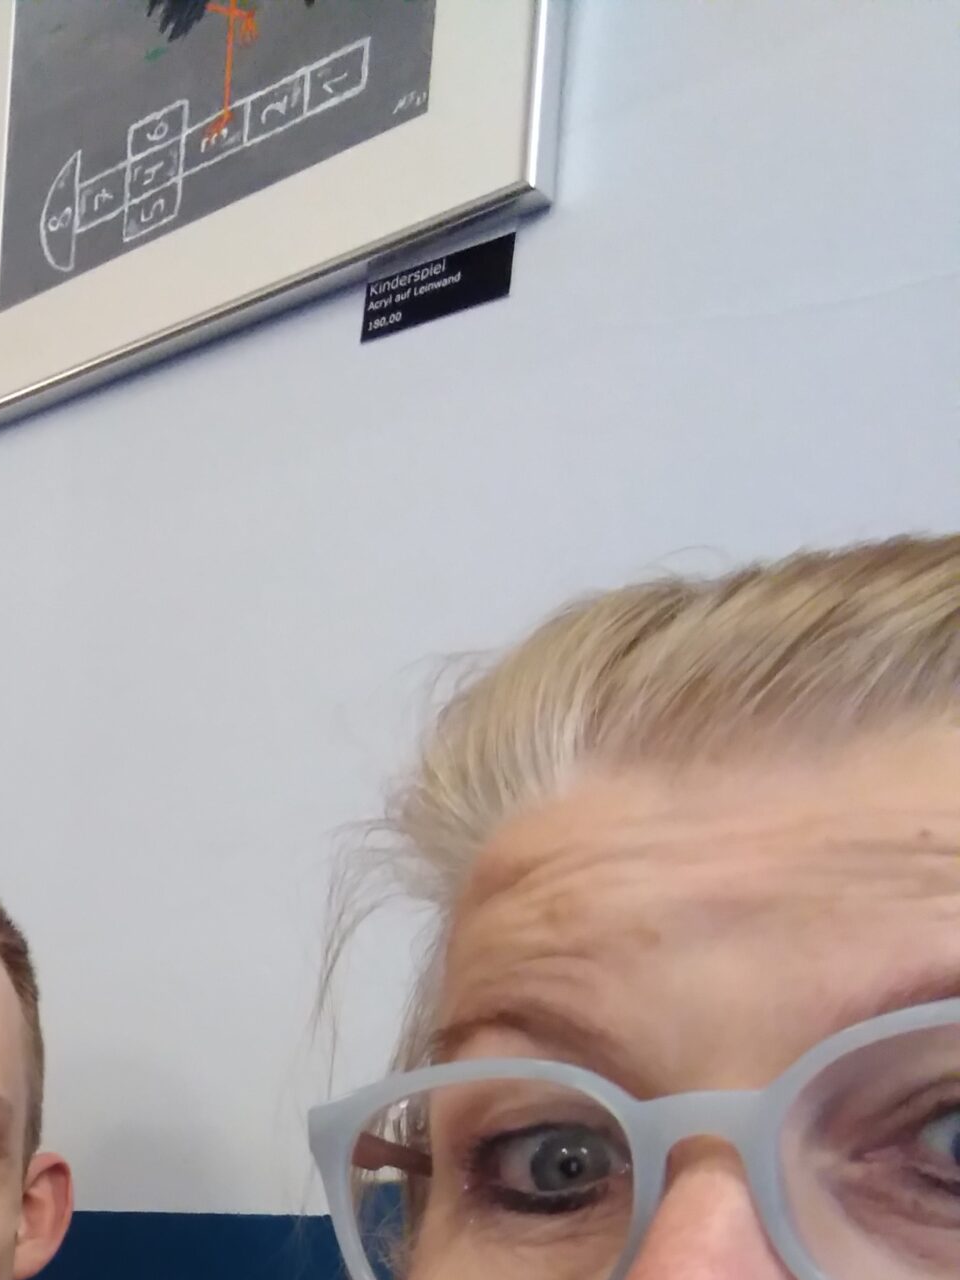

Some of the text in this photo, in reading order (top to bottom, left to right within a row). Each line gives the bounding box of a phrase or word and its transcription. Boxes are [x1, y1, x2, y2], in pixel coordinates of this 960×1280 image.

[259, 95, 289, 125] 2
[146, 120, 169, 142] 6
[93, 187, 114, 212] 7
[140, 198, 165, 223] 5
[47, 206, 72, 232] 8
[369, 257, 446, 297] Kinderspiel
[367, 271, 461, 311] Acryl auf Leinwand
